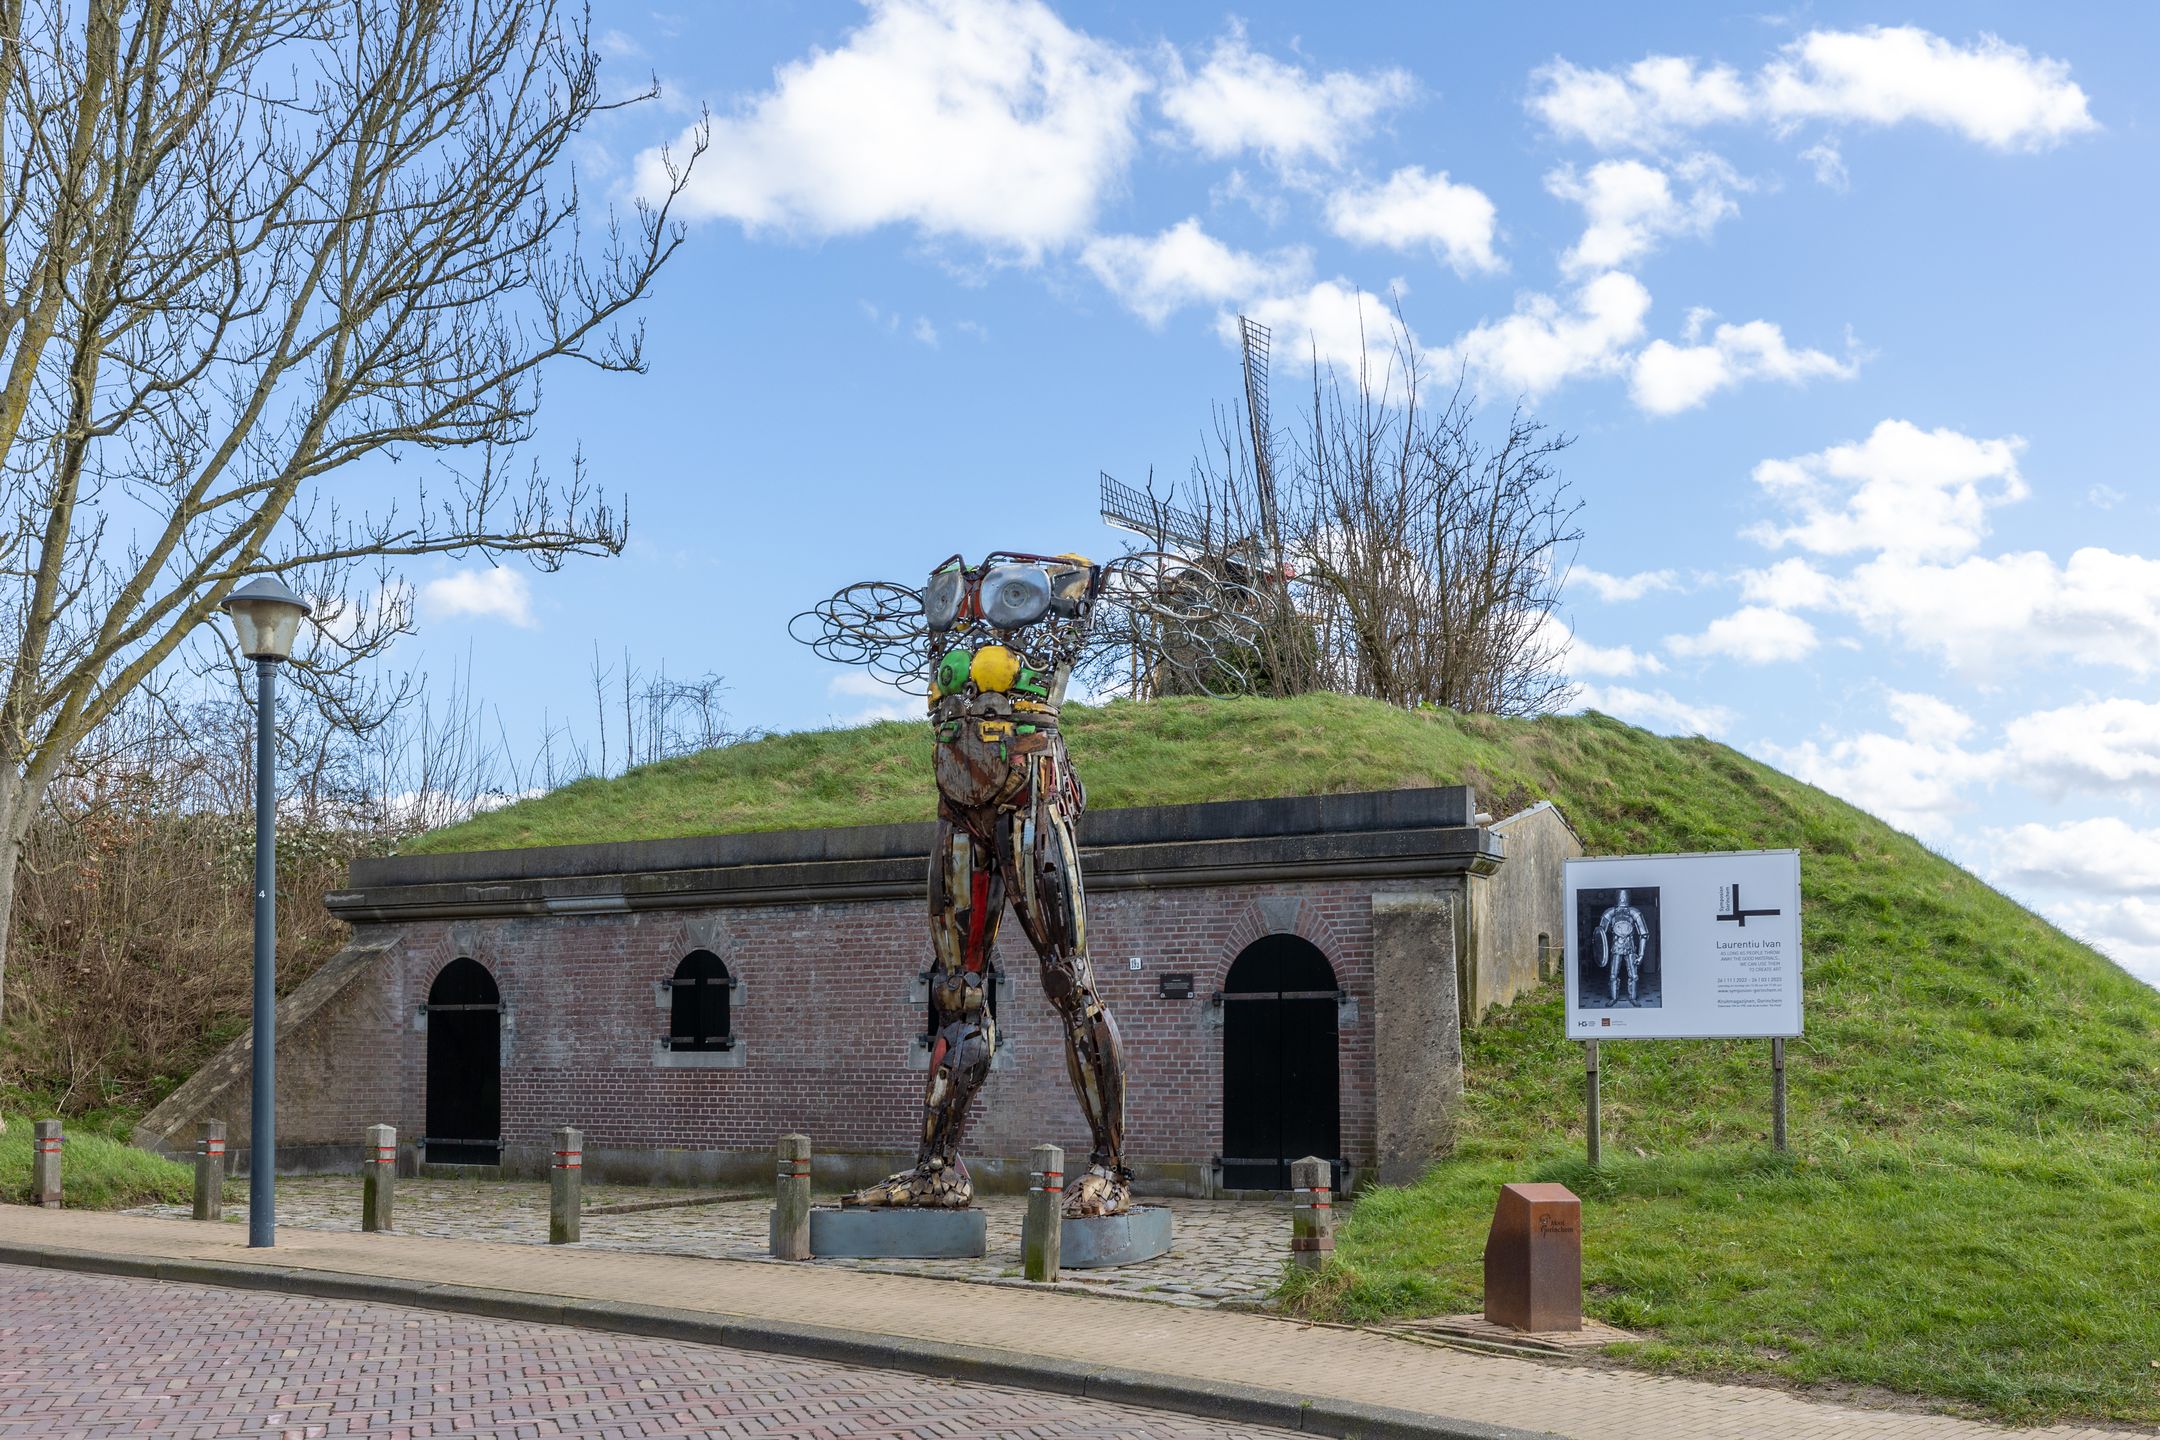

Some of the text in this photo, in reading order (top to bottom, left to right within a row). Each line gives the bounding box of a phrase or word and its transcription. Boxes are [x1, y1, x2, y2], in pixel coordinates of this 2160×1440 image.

[259, 889, 266, 898] 4
[1716, 939, 1781, 949] Laurentiu Ivan
